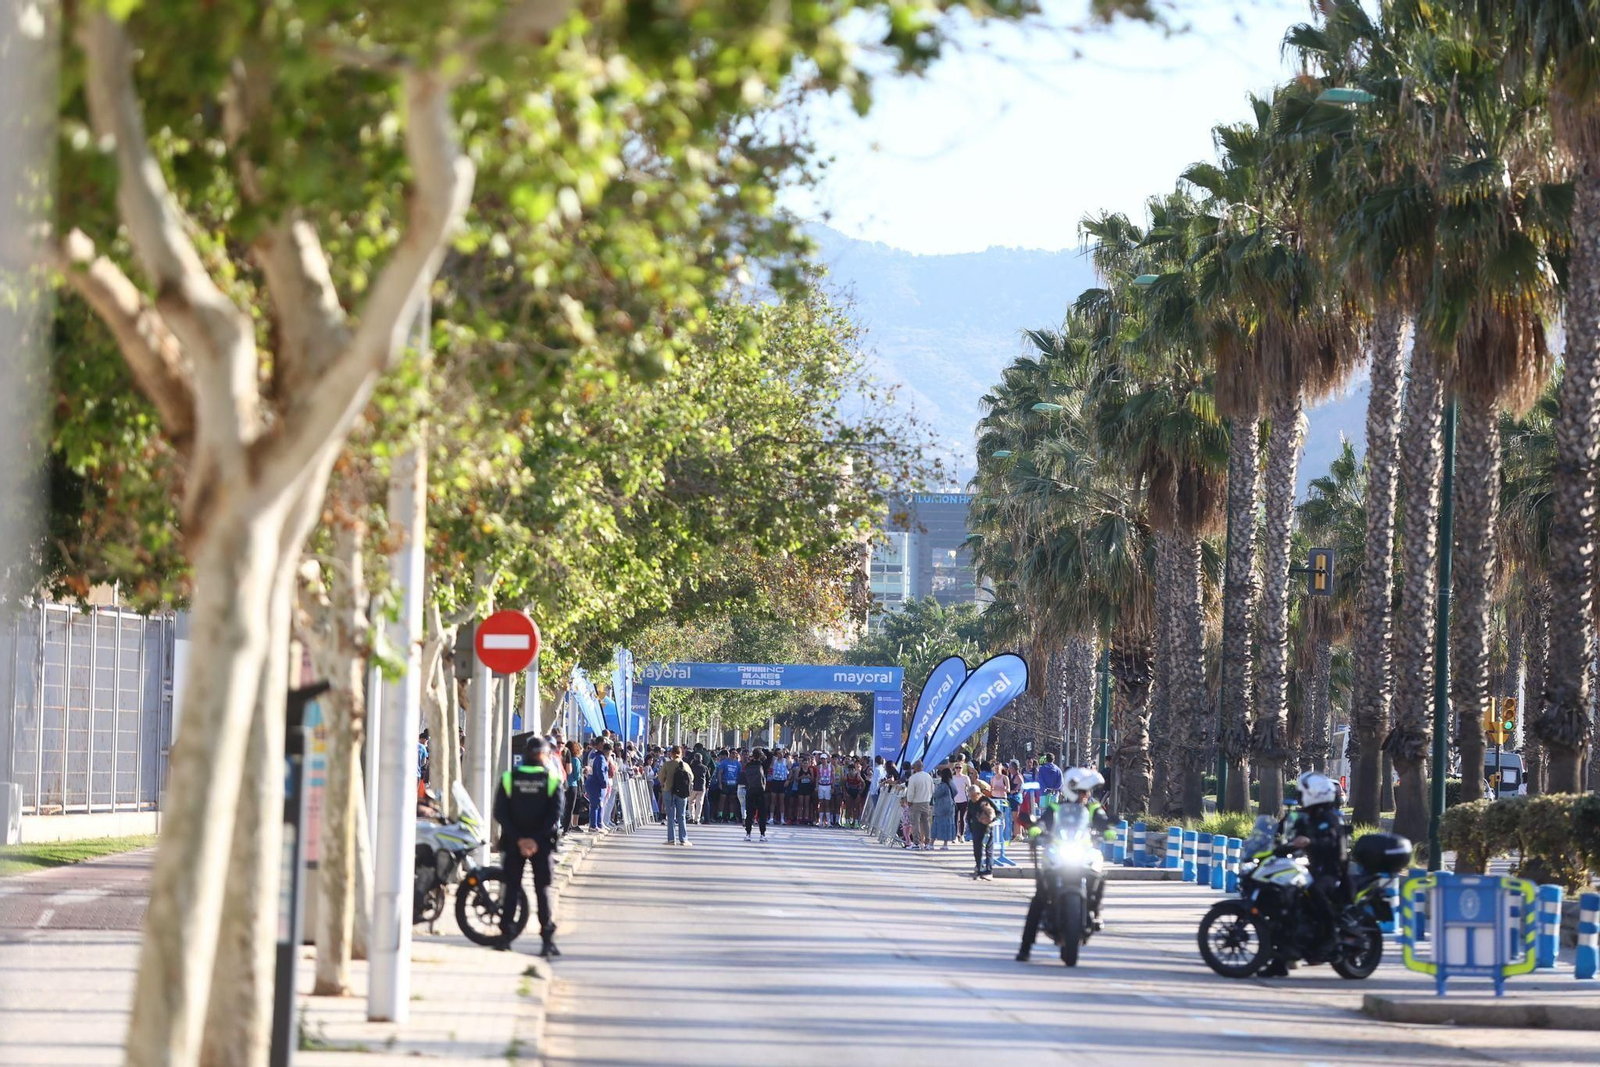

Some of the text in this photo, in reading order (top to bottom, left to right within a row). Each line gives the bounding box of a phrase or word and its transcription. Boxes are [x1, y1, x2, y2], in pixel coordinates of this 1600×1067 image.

[915, 494, 957, 504] ILUNION
[833, 671, 893, 685] mayoral
[914, 673, 955, 740] mayoral
[946, 671, 1012, 738] mayoral
[513, 754, 523, 766] P
